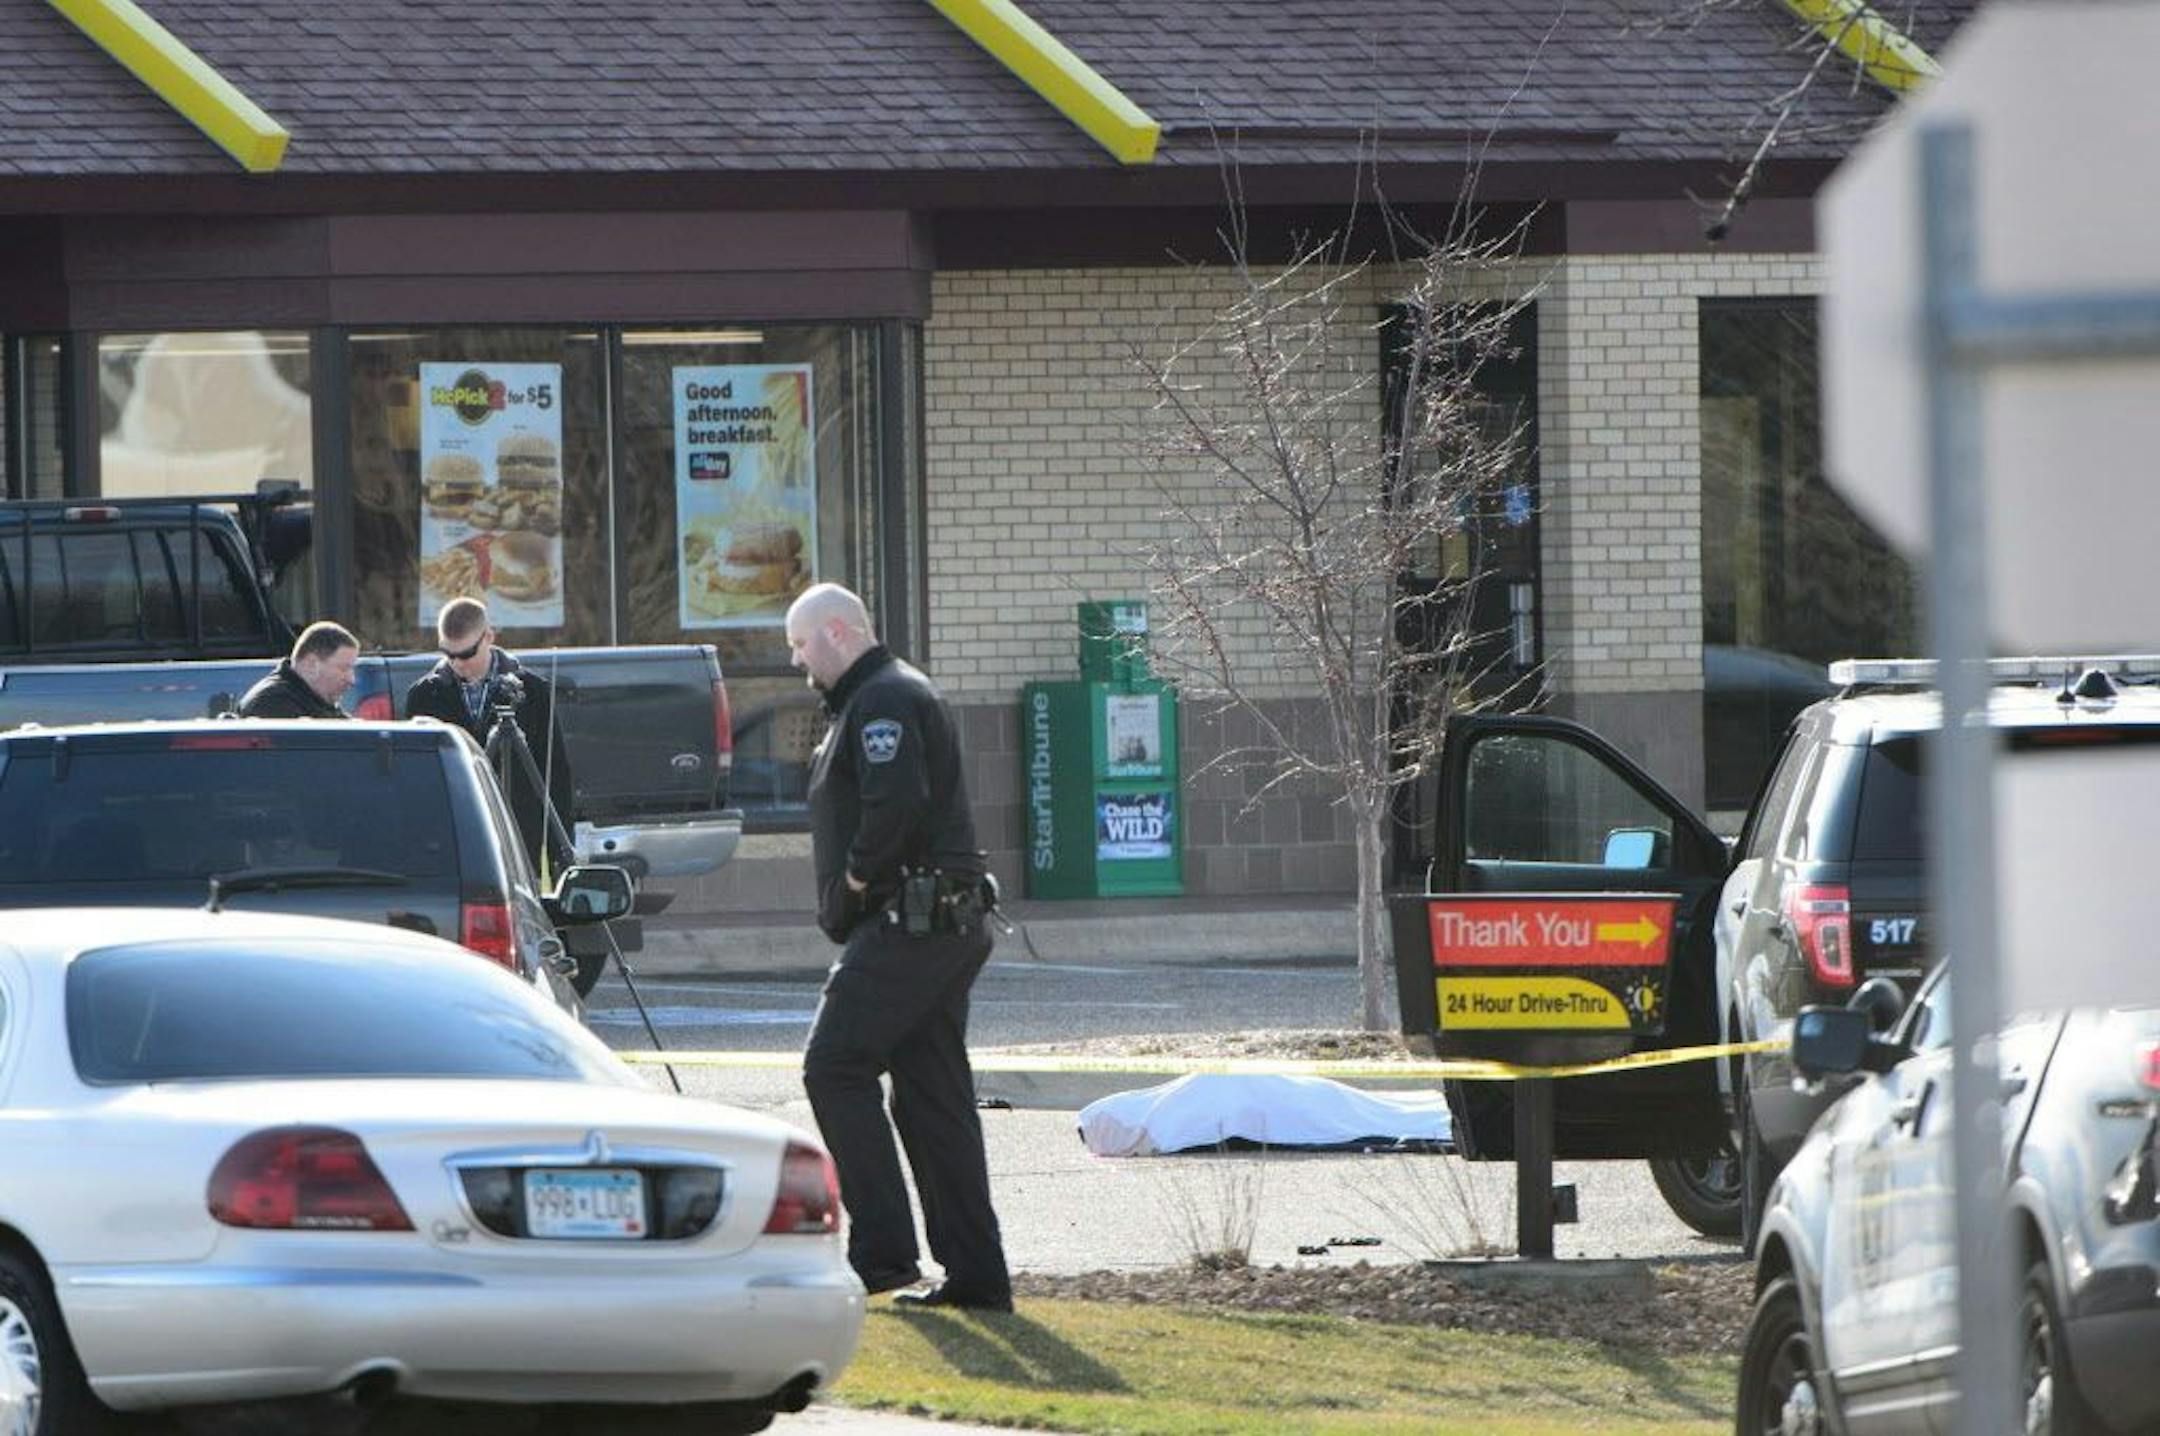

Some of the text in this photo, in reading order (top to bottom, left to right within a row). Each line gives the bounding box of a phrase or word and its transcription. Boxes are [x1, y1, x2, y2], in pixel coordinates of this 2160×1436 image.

[508, 391, 525, 403] for
[527, 384, 552, 410] $5
[687, 382, 732, 400] Good
[688, 426, 778, 444] breakfast.
[1032, 692, 1053, 870] StarTribune
[1106, 817, 1163, 841] WILD
[1437, 911, 1591, 947] Thank You
[1871, 919, 1916, 944] 517
[1447, 992, 1608, 1013] 24 Hour Drive-Thru
